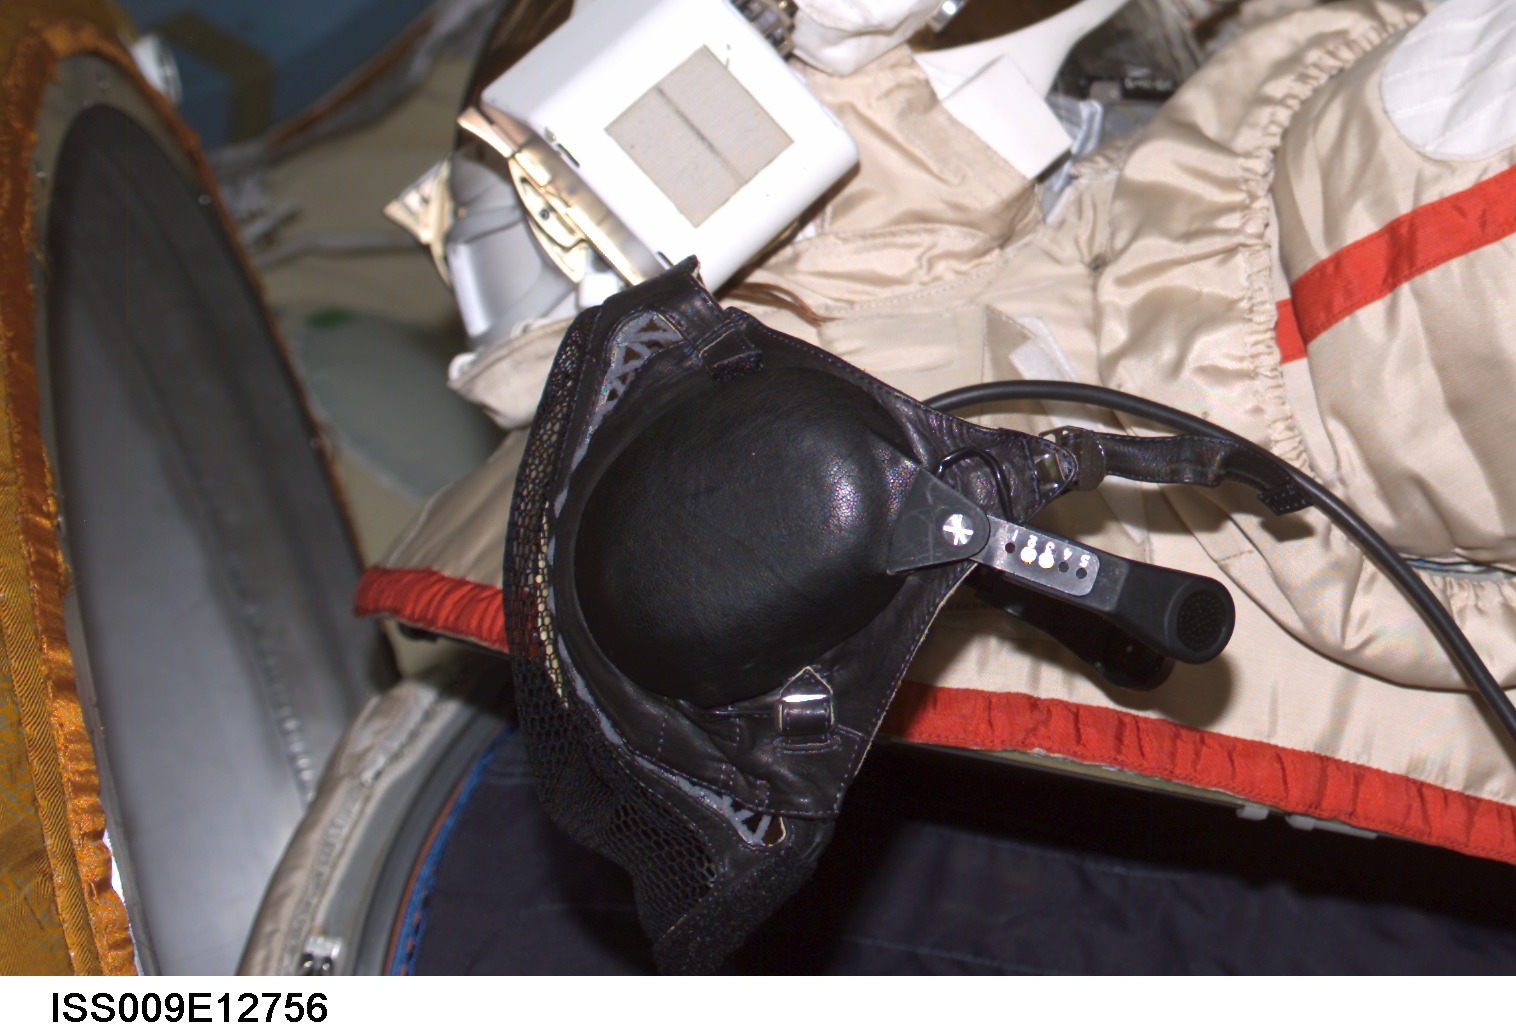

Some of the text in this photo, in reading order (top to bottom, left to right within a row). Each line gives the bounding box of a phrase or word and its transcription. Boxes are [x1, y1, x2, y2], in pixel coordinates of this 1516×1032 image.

[1012, 529, 1091, 568] 1 2 3 4 5
